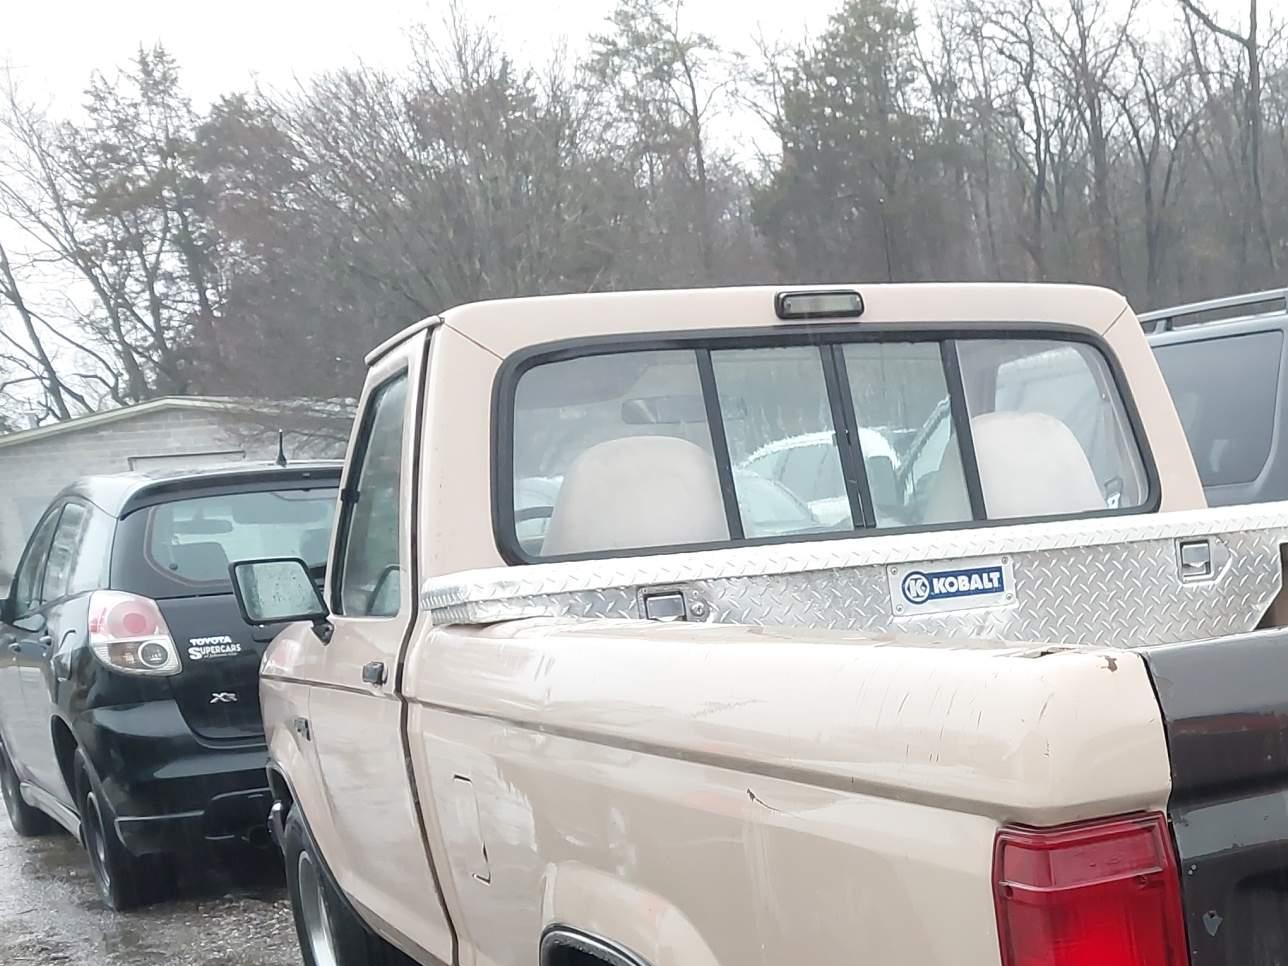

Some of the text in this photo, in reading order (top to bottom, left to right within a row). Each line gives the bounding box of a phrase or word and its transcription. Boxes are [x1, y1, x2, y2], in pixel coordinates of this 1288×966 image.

[932, 571, 1000, 595] KOBALT
[189, 635, 232, 646] TOYOTA
[188, 643, 241, 660] SUPERCARS
